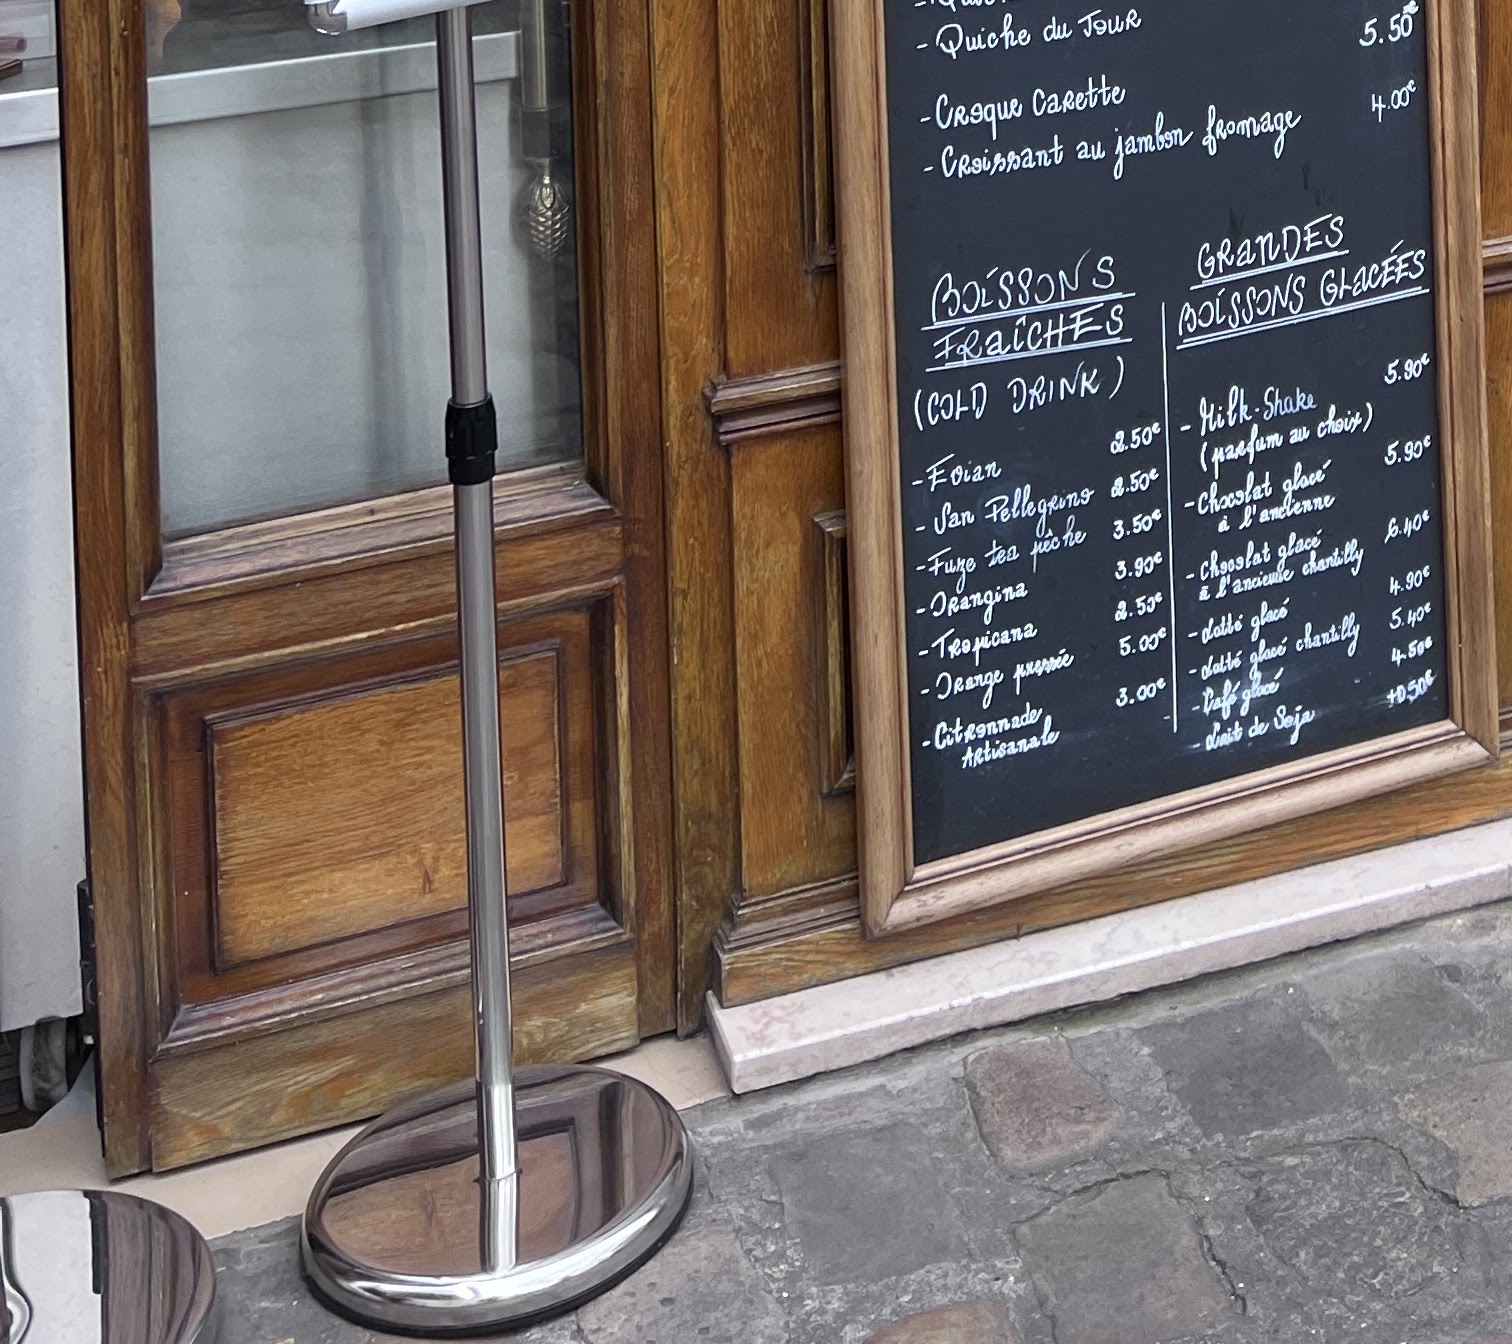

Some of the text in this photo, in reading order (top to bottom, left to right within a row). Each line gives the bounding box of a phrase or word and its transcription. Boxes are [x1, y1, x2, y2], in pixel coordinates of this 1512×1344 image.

[936, 13, 1031, 59] Quiche
[1043, 16, 1072, 42] du
[935, 75, 1126, 139] Croque Carette
[941, 144, 1064, 179] Croissant
[1077, 141, 1105, 161] au
[1113, 113, 1194, 180] jambon
[1202, 105, 1302, 159] fromage
[1198, 213, 1345, 277] GRANDES
[932, 249, 1116, 322] BOISSONS
[1178, 276, 1306, 335] BOISSONS
[1200, 402, 1373, 479] (parfum au choix)
[1197, 467, 1273, 516] Chocolat
[934, 502, 975, 535] San
[984, 541, 1020, 568] tea
[1031, 515, 1087, 572] pêche
[1199, 540, 1272, 582] Chocolat
[931, 582, 1027, 624] Orangina
[932, 622, 1038, 666] Tropicana
[1296, 615, 1361, 658] chantilly
[935, 669, 1004, 708] Orange
